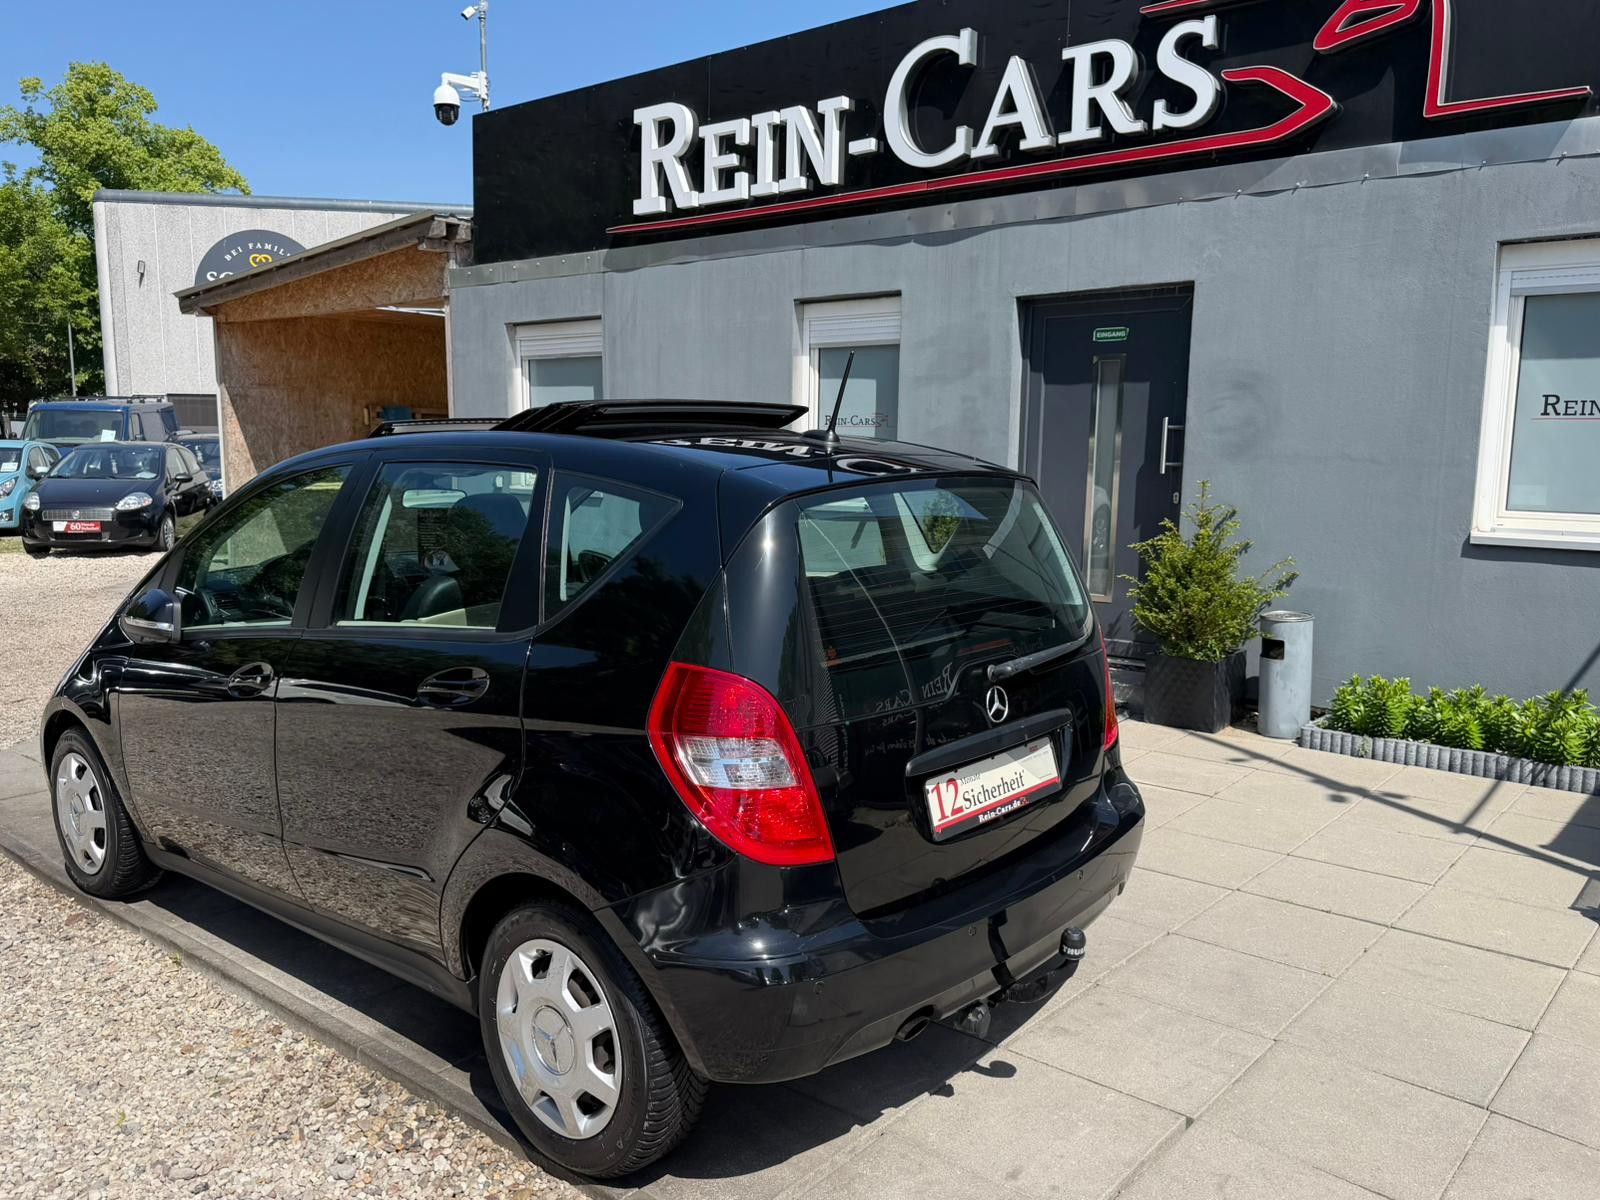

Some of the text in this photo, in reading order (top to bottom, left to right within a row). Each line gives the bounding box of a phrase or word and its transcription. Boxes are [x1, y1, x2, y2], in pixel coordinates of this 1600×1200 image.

[632, 15, 1223, 216] REIN-CARS
[224, 242, 291, 262] BEI FAMIL
[1096, 330, 1126, 338] EINGANG
[825, 415, 877, 425] RIN-CARS
[70, 522, 80, 530] 60
[931, 777, 965, 823] 12
